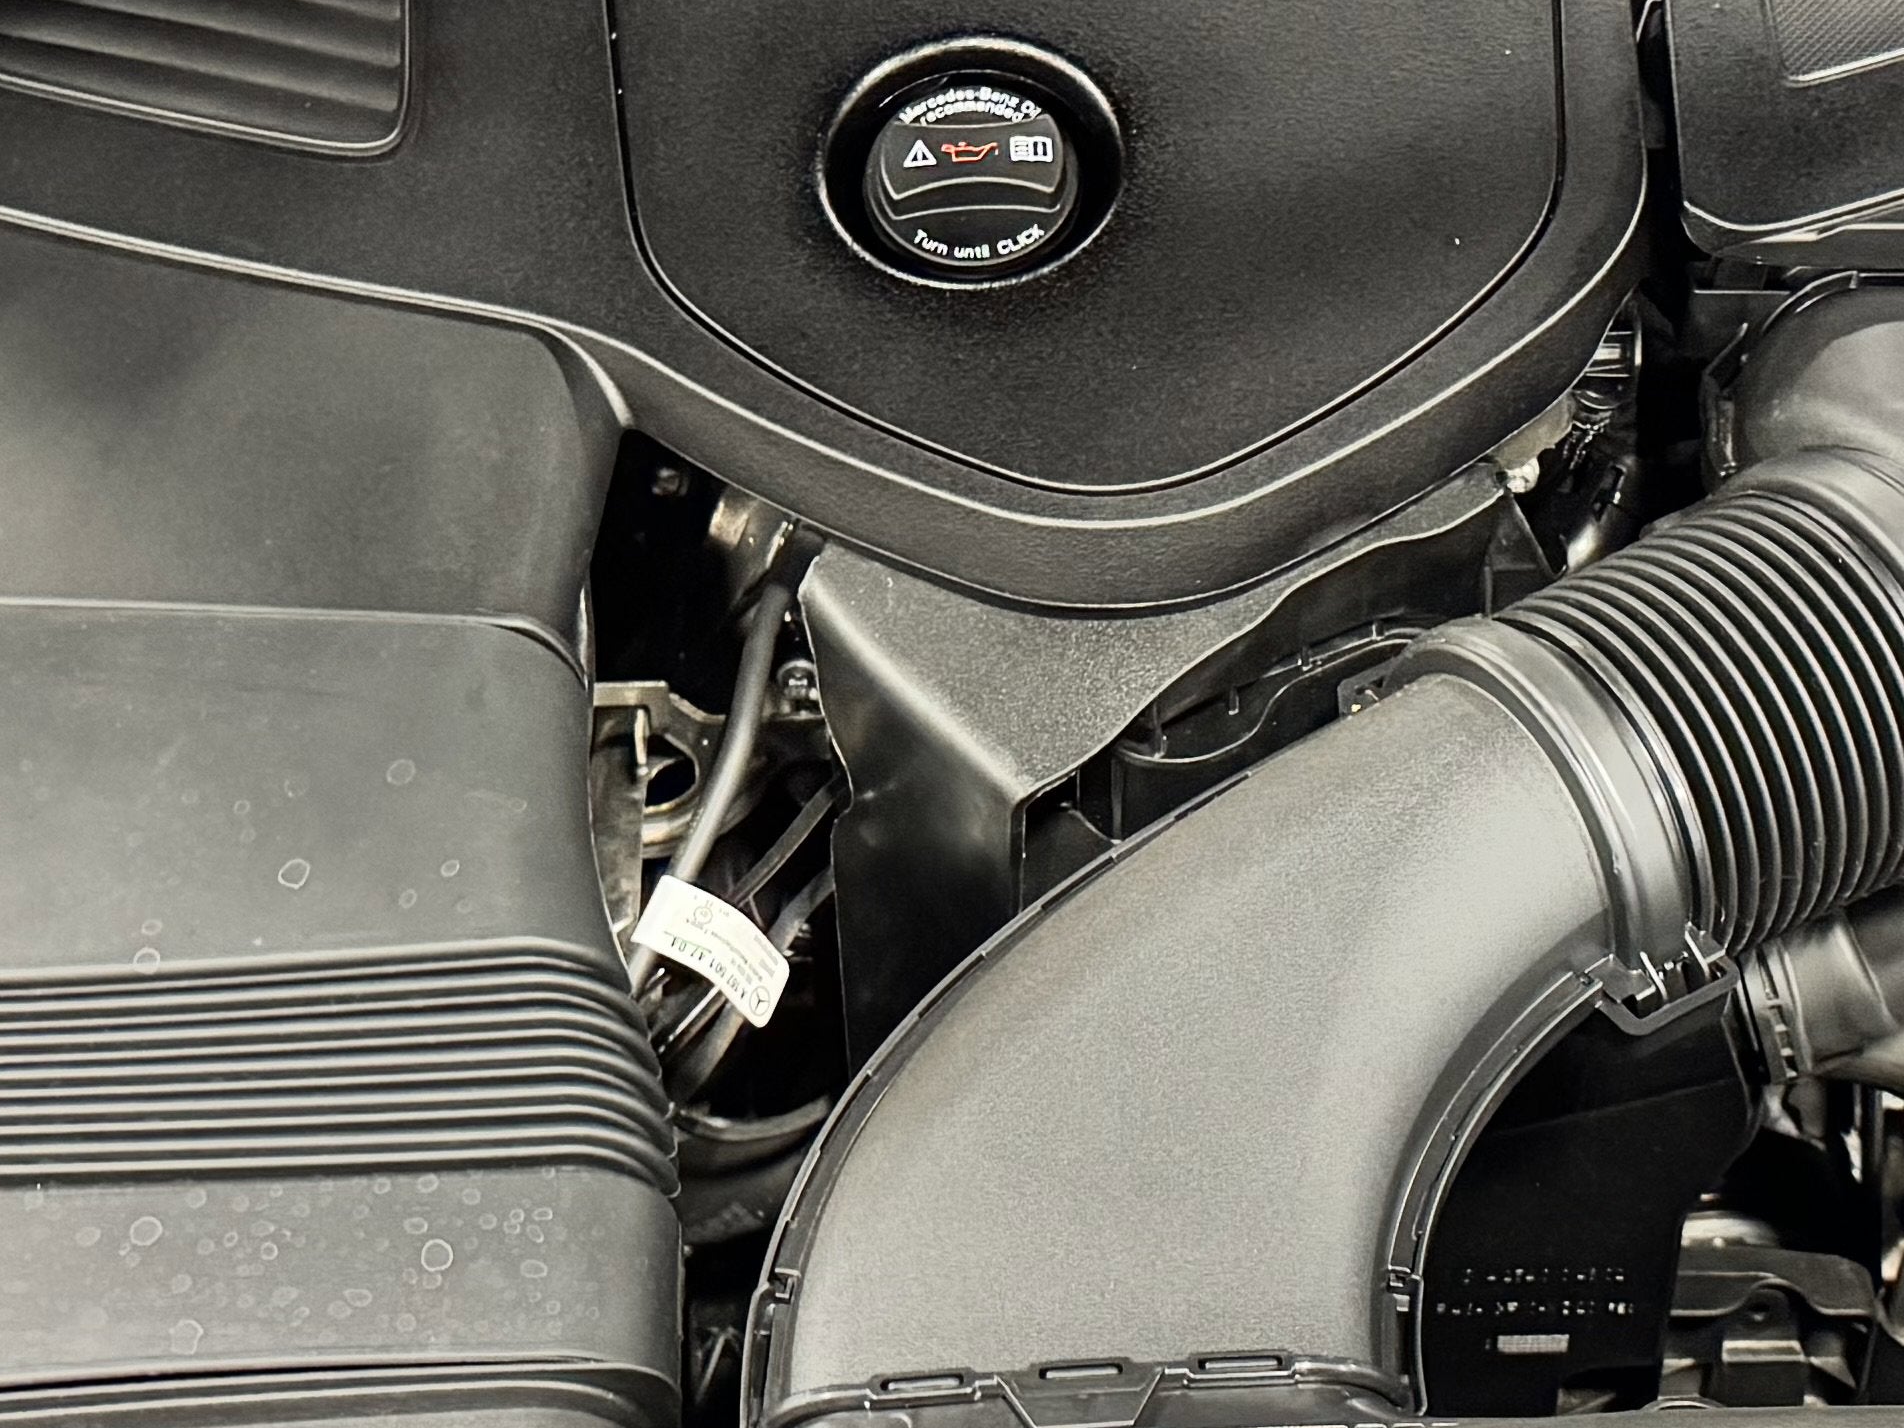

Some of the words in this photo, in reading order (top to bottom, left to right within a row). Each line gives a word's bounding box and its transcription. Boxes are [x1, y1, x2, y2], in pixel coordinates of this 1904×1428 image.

[899, 86, 1019, 124] Mercedes-Benz
[920, 100, 1024, 126] recommended
[914, 229, 948, 255] Turn
[954, 244, 990, 258] until
[997, 224, 1044, 255] CLICK
